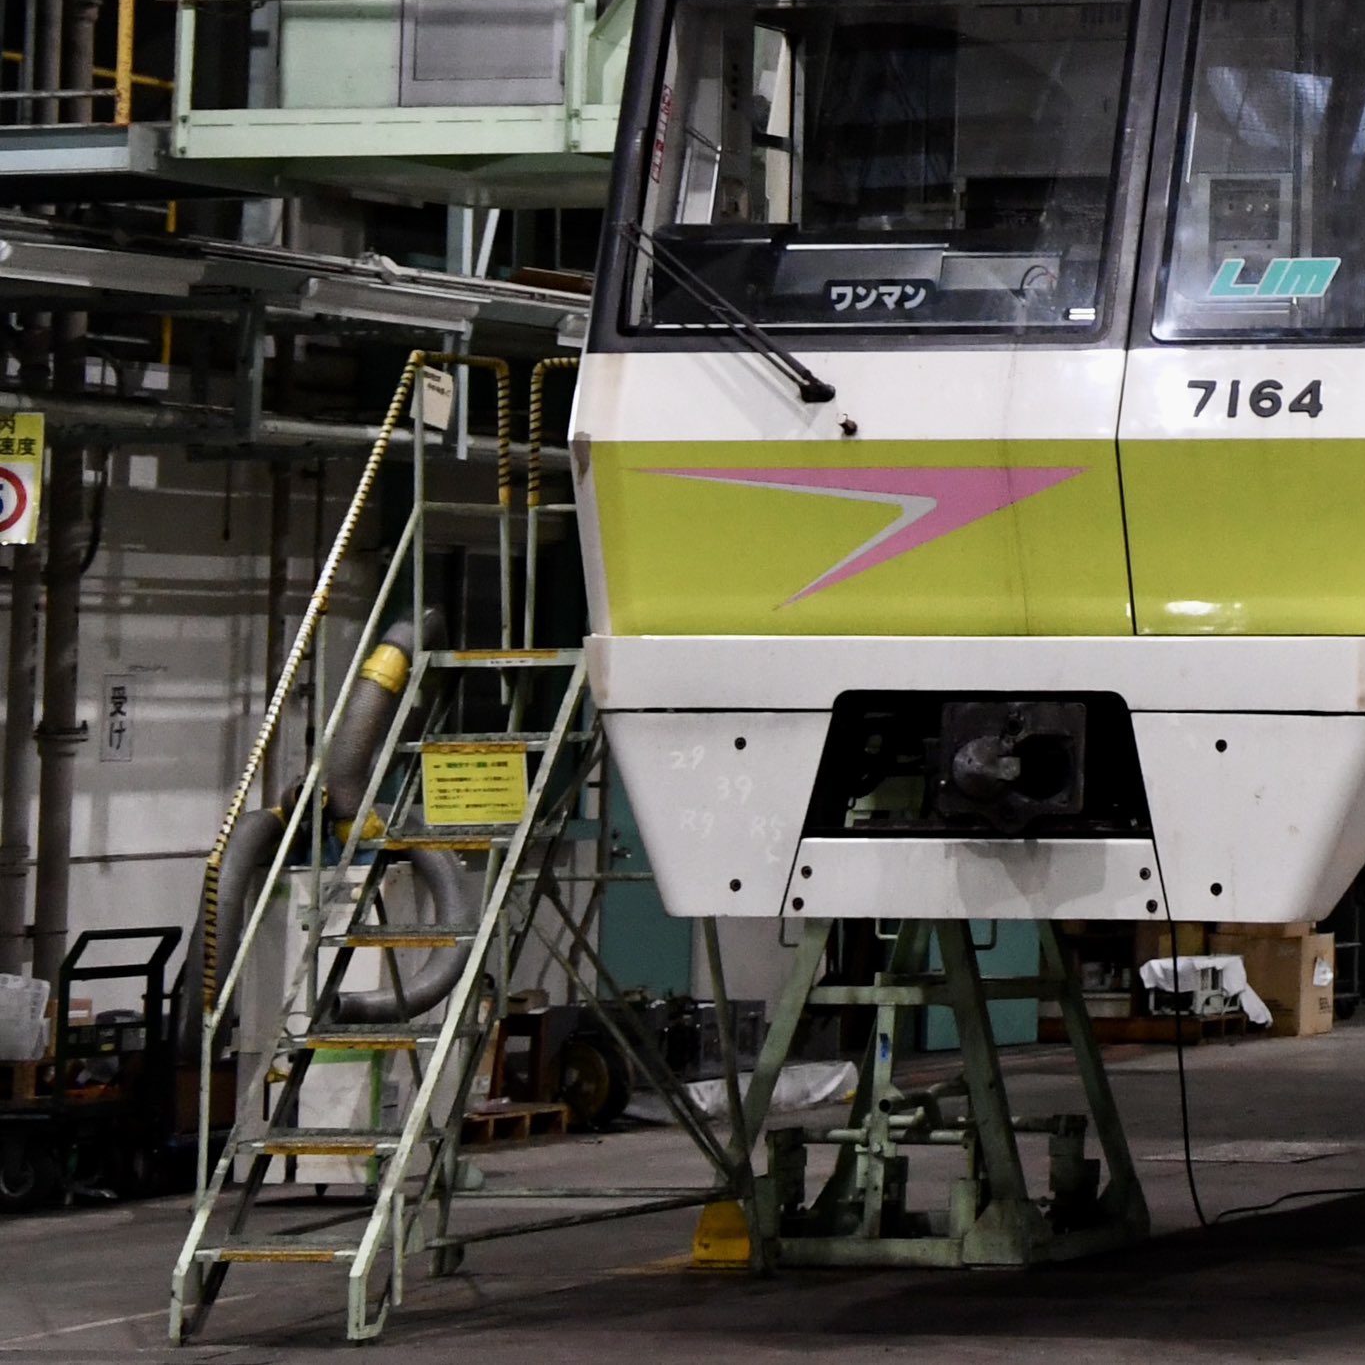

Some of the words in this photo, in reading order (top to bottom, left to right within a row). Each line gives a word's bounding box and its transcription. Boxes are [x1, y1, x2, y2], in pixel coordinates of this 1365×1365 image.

[1206, 257, 1341, 297] LIM
[830, 284, 926, 312] ワンマン
[1187, 379, 1323, 418] 7164
